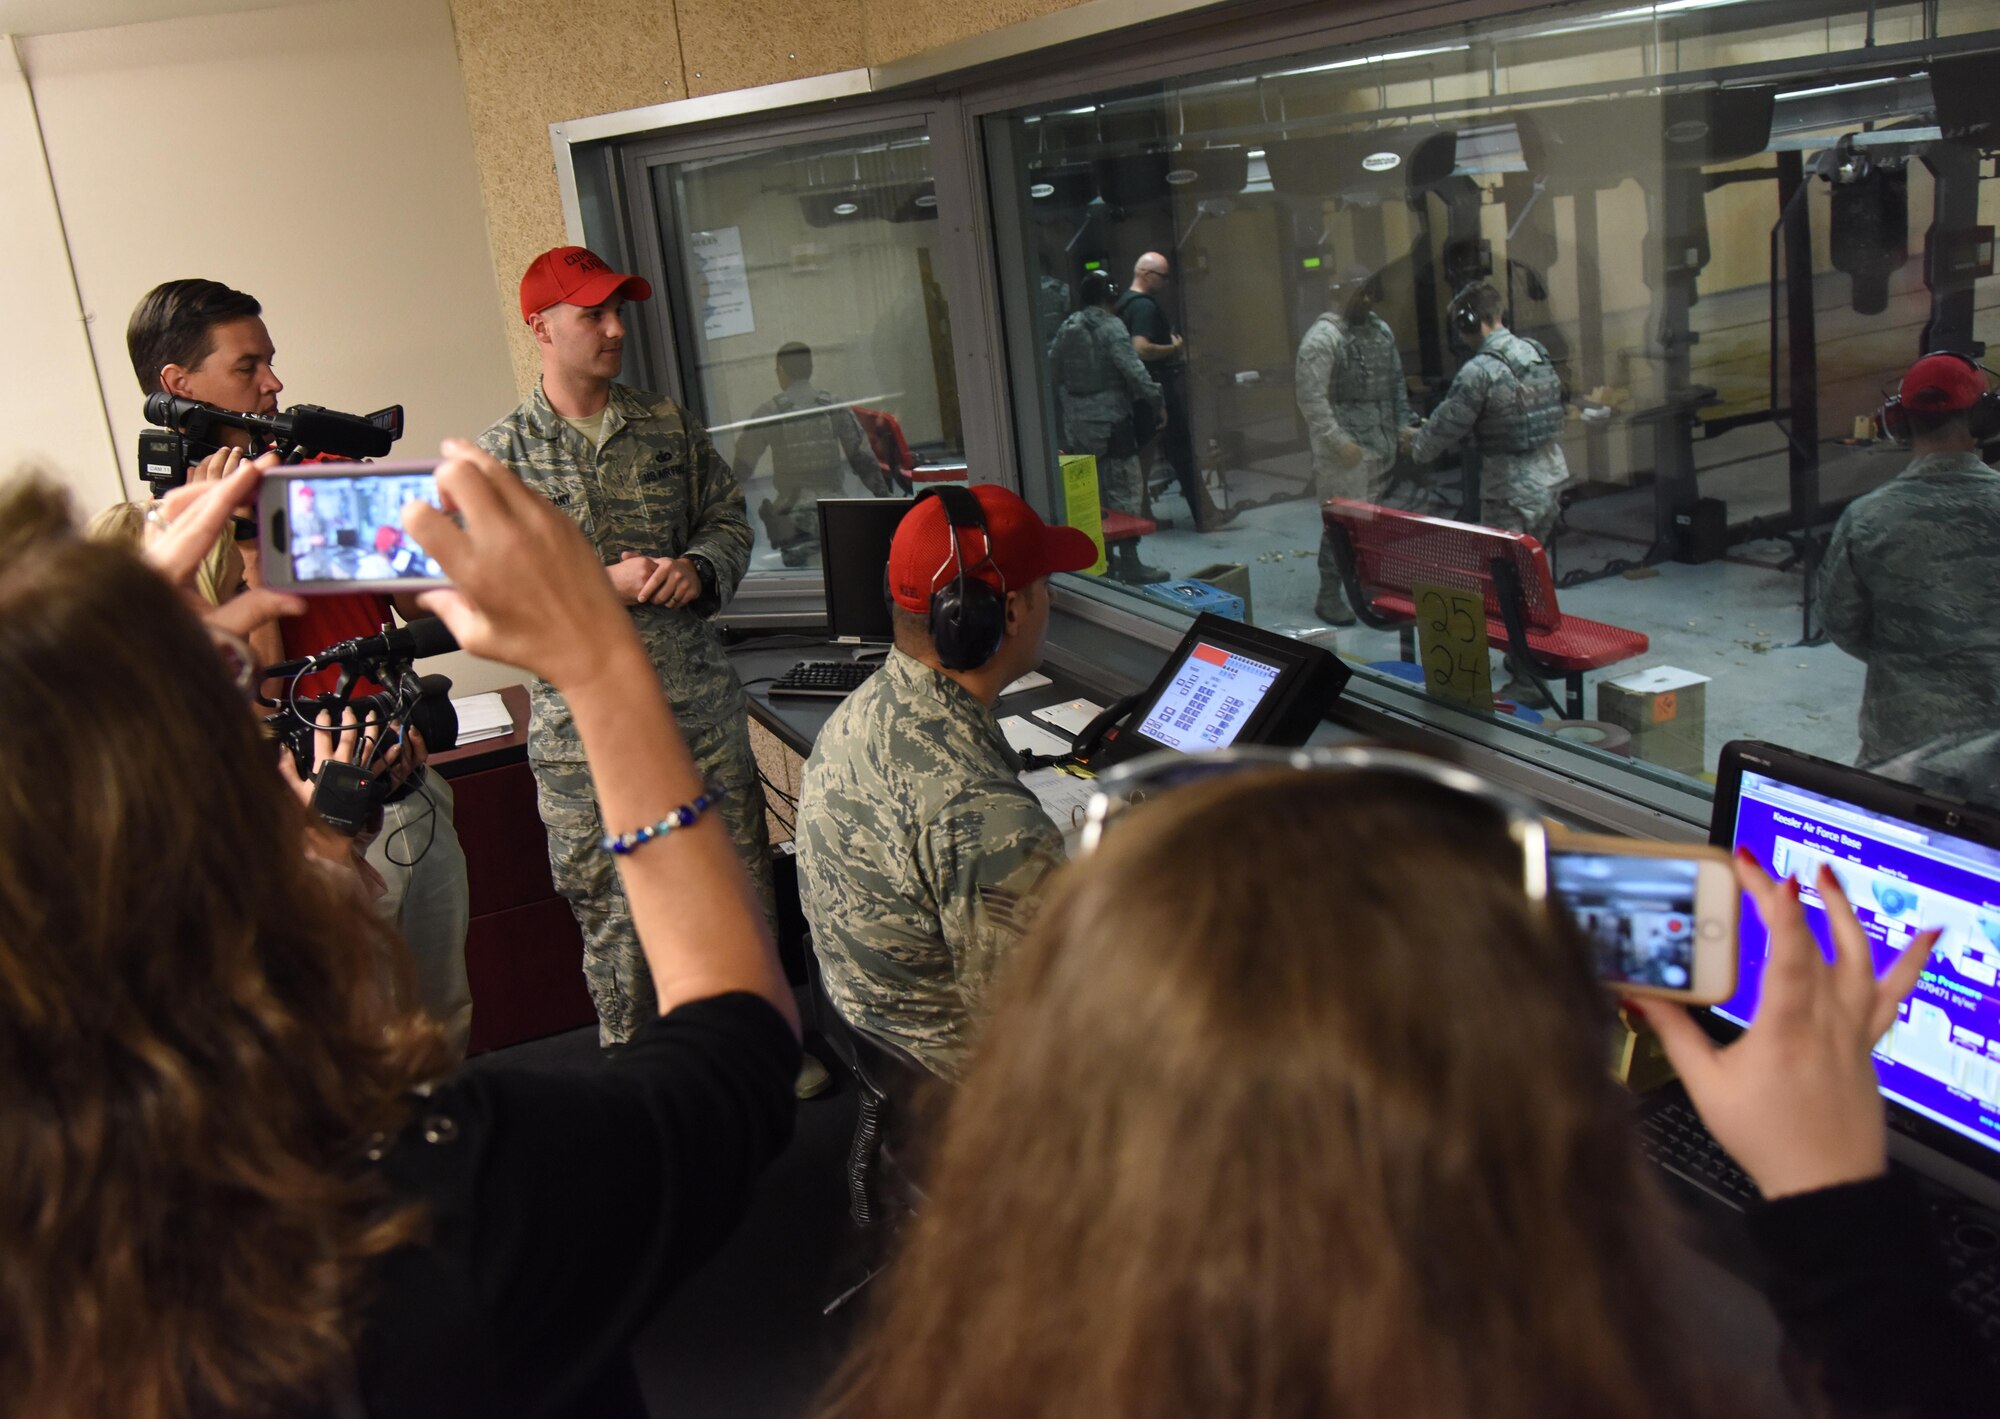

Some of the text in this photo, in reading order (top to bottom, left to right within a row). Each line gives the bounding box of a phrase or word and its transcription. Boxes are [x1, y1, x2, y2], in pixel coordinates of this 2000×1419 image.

[1422, 591, 1476, 643] 25
[1430, 644, 1482, 698] 24
[1772, 811, 1862, 850] Keesler Air Force Base
